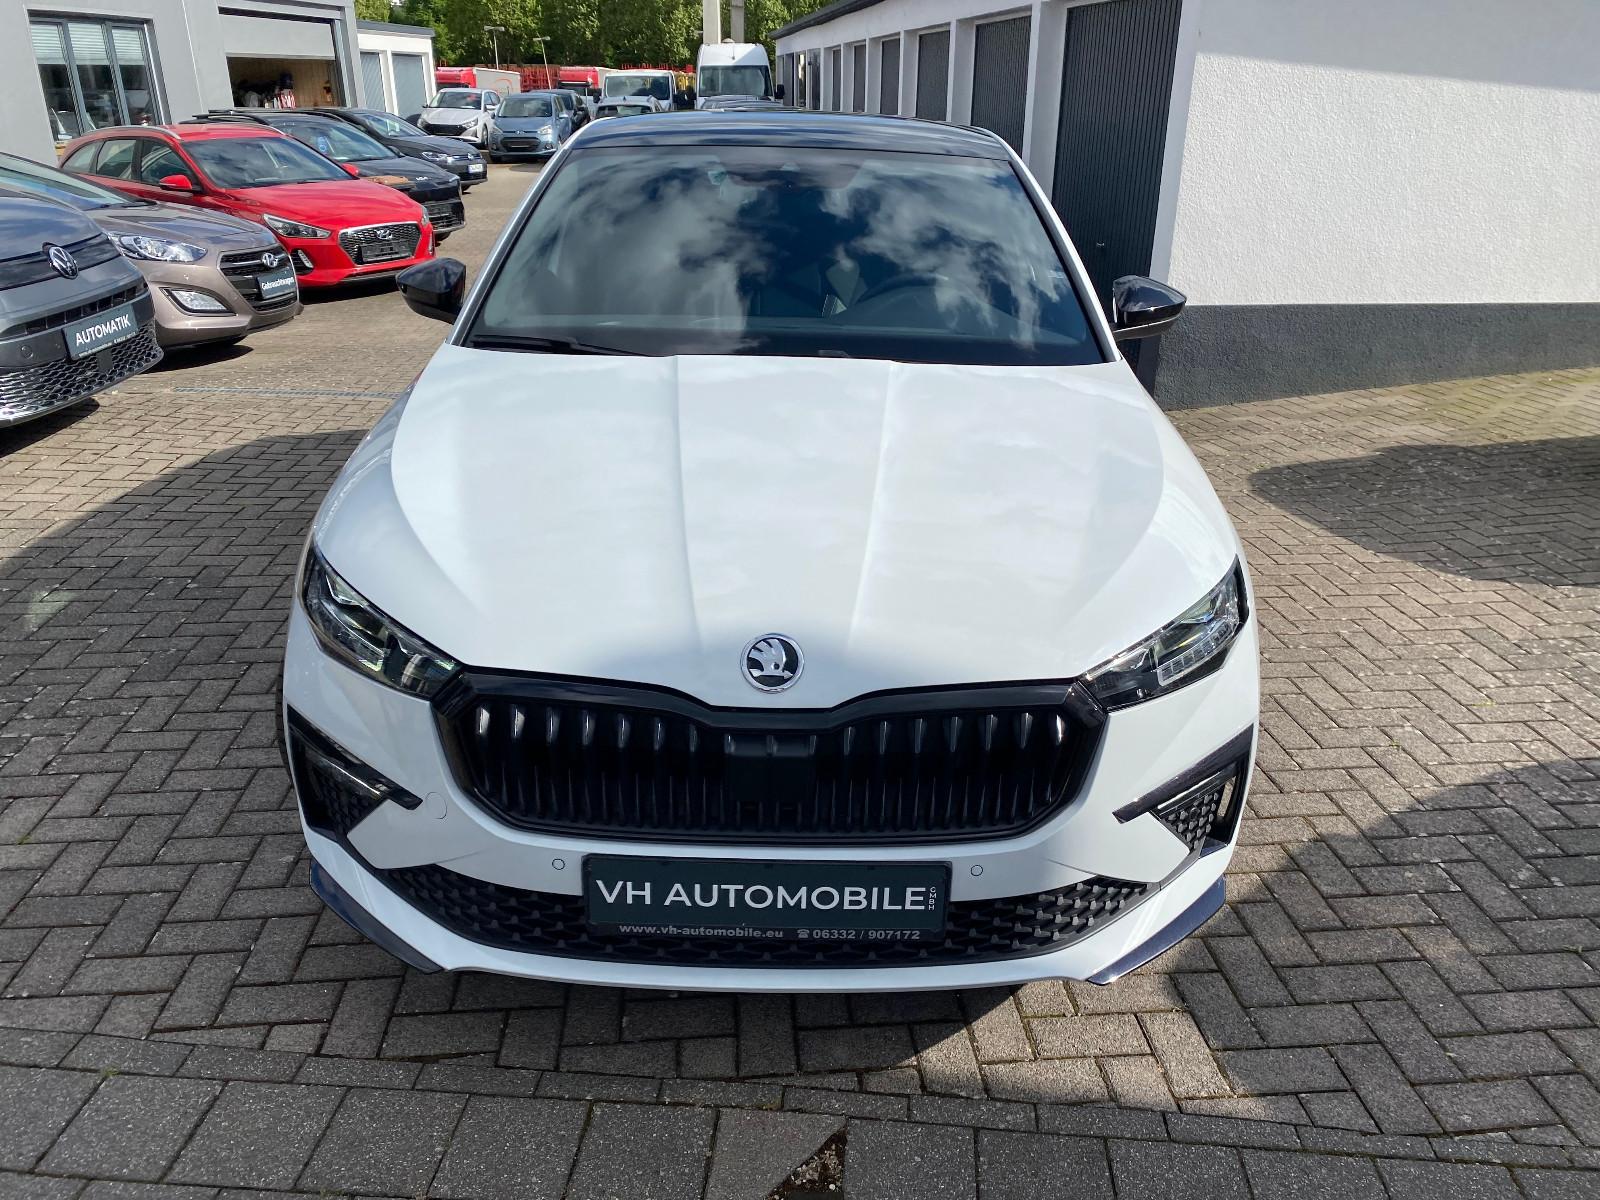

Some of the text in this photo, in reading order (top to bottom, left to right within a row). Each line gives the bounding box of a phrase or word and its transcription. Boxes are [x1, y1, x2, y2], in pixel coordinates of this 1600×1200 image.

[75, 313, 132, 347] AUTOMATIK
[595, 879, 927, 911] VH AUTOMOBILE
[619, 924, 784, 939] www.vh-automobile.eu
[812, 929, 856, 940] 06332
[867, 930, 921, 941] 907172
